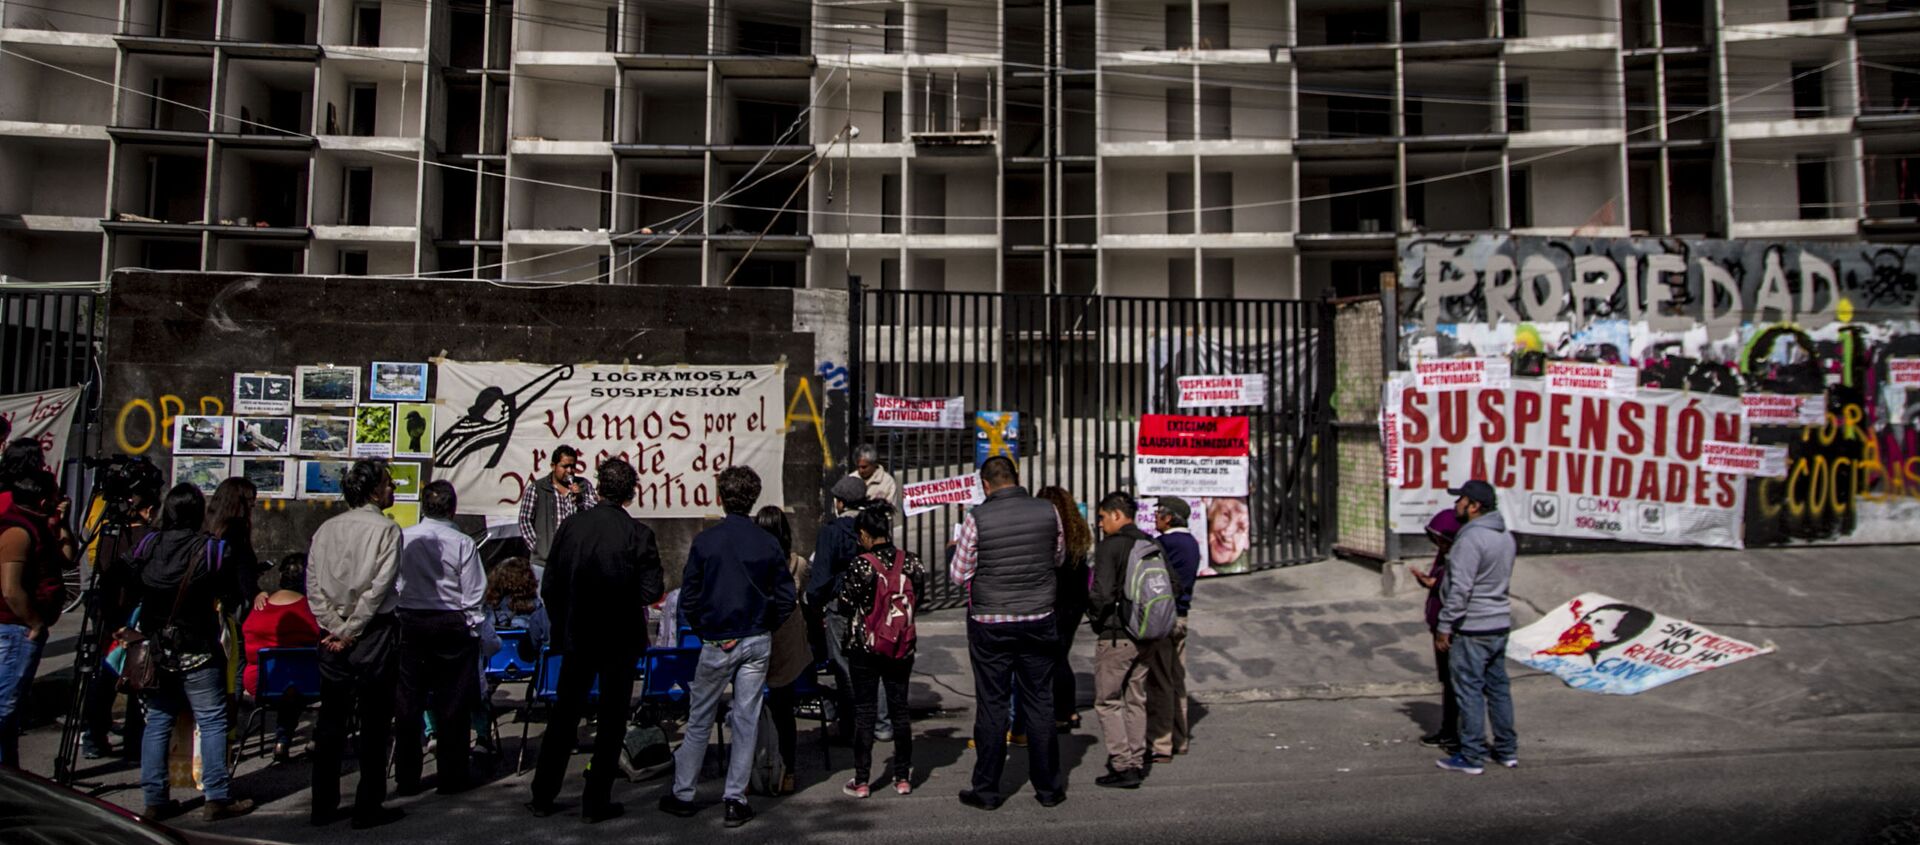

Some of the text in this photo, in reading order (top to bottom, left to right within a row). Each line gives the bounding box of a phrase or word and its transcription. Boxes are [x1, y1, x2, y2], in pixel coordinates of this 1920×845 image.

[1421, 244, 1840, 340] PROPIEDAD
[591, 370, 758, 383] LOGRAMOS LA
[591, 384, 742, 397] SUSPENSIÓN
[544, 395, 767, 441] Vamos por el
[877, 410, 940, 422] ACTIVIDADES
[1402, 387, 1739, 461] SUSPENSIÓN
[532, 436, 736, 475] rscte del
[1386, 412, 1398, 478] ACTIVIDADES
[903, 475, 976, 498] SUSPENSIÓN DE
[1400, 447, 1449, 489] DE
[1471, 448, 1736, 508] ACTIVIDADES
[909, 489, 972, 509] ACTIVIDADES
[1576, 496, 1621, 514] CDMX
[1659, 621, 1702, 641] SIN
[1654, 639, 1692, 655] NO
